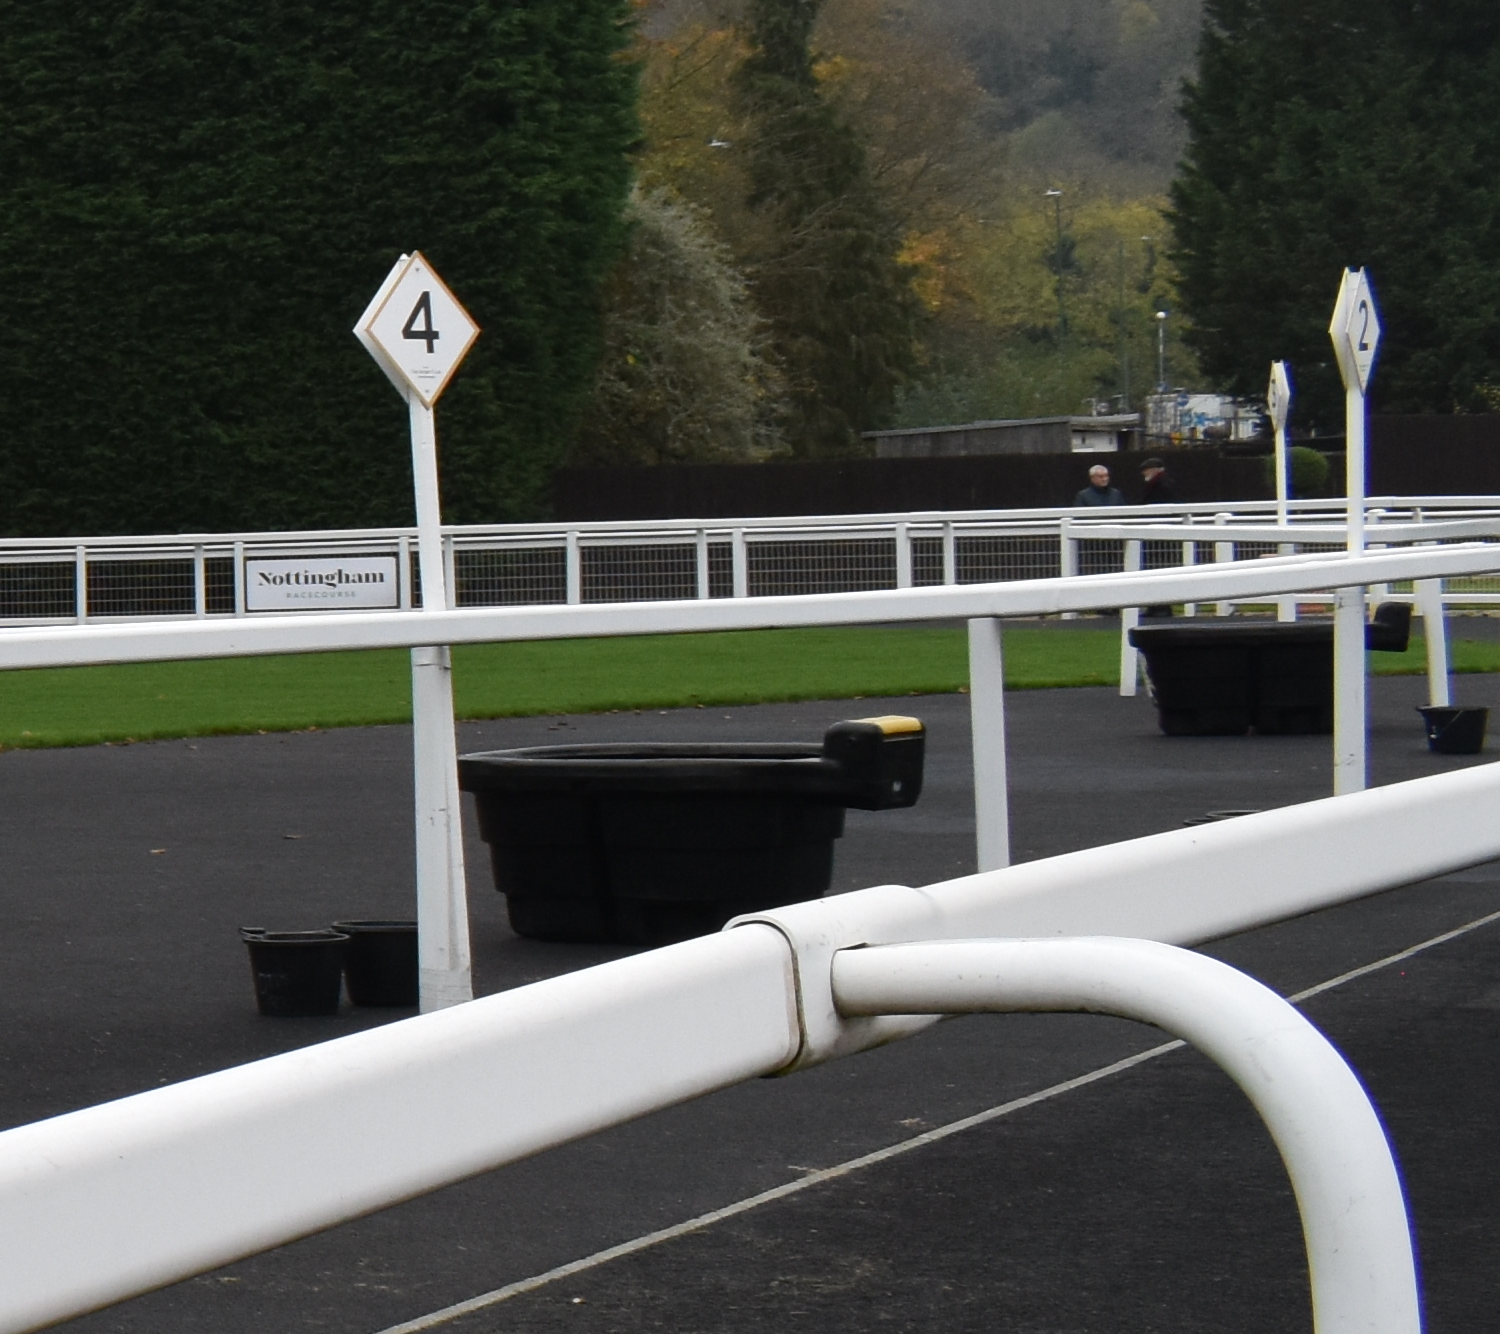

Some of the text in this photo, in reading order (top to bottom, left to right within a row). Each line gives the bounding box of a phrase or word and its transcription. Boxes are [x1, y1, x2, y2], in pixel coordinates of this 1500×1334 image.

[401, 290, 440, 354] 4
[1358, 299, 1369, 351] 2
[258, 568, 385, 588] Nottingham
[286, 590, 357, 599] RACECOURSE
